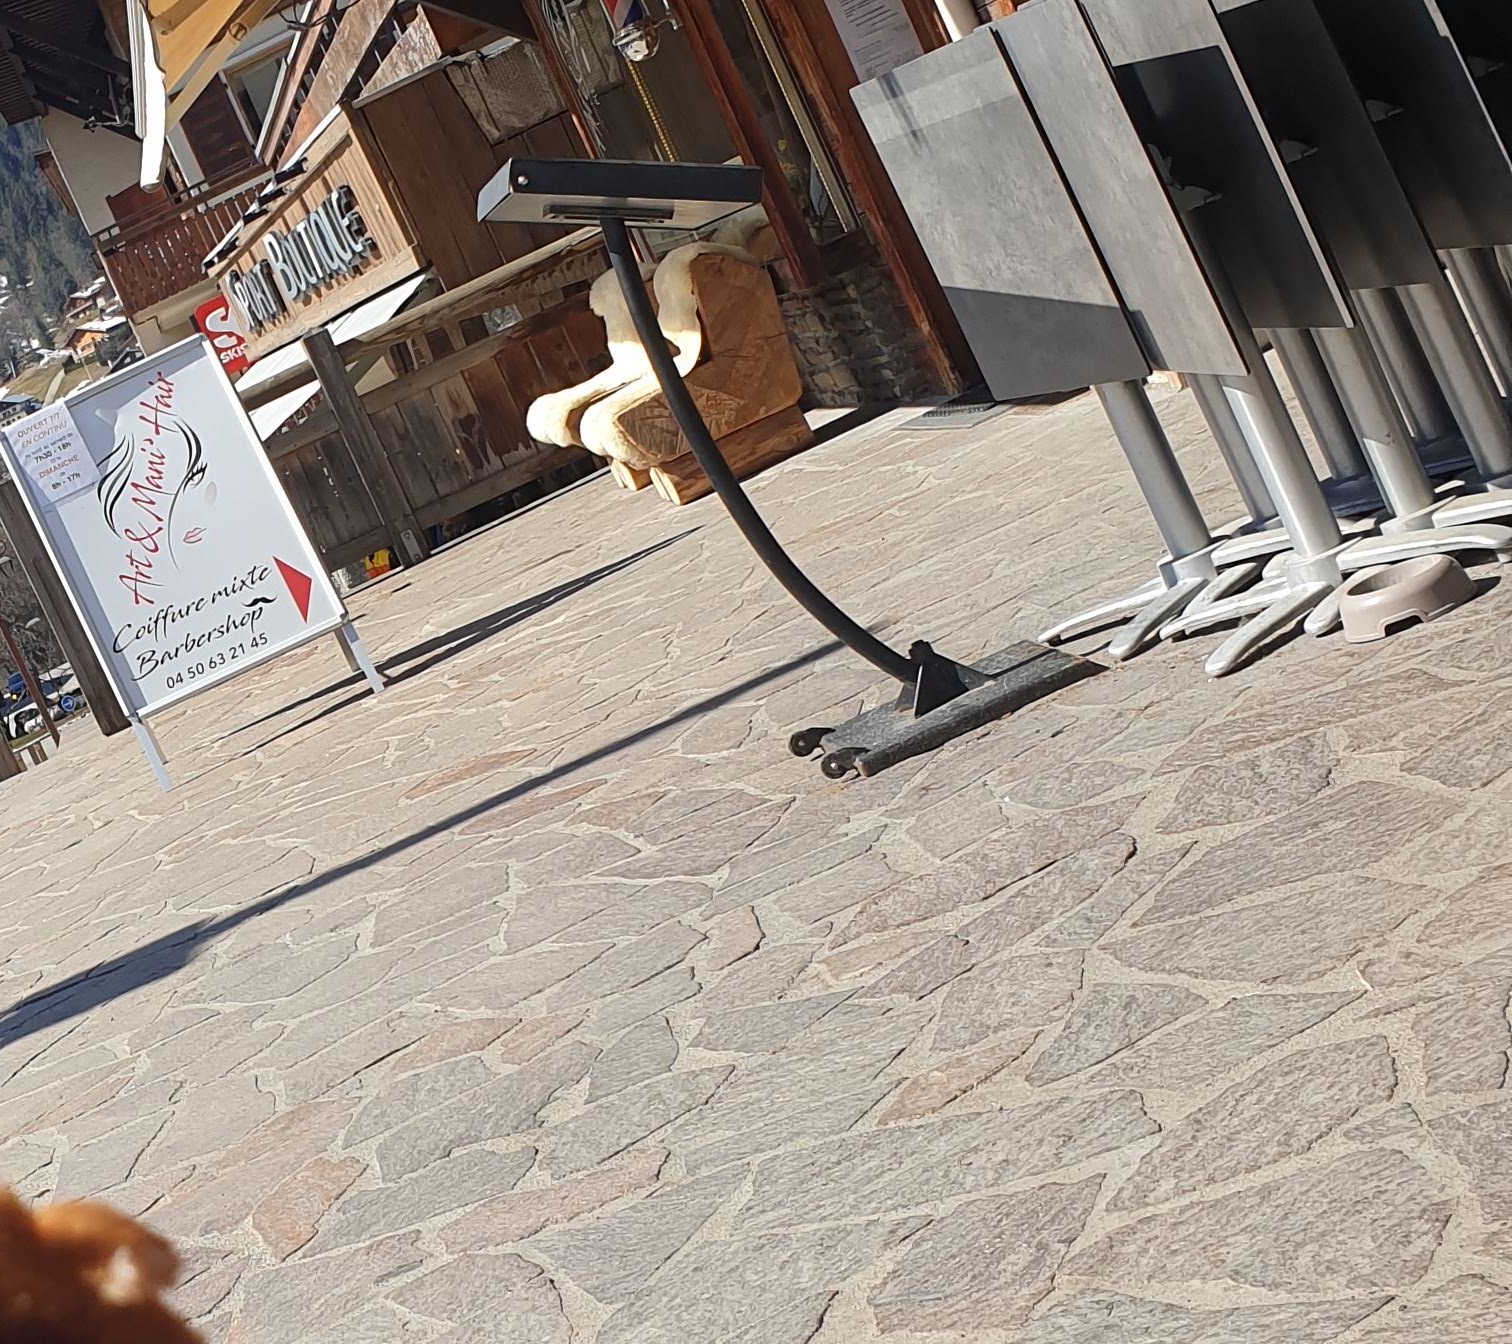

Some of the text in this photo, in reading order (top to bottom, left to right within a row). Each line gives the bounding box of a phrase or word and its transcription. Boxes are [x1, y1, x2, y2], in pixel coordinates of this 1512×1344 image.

[225, 184, 370, 333] SPORT BOUTIQUE
[17, 418, 48, 438] OUVERT
[139, 371, 180, 436] Hair
[33, 421, 67, 443] CONTINU
[39, 455, 80, 479] DIMANCHE
[124, 521, 164, 554] &
[119, 549, 163, 605] Art
[112, 564, 272, 654] Coiffure mixte
[130, 606, 264, 682] Barbershop
[166, 632, 268, 689] 04 50 63 21 45
